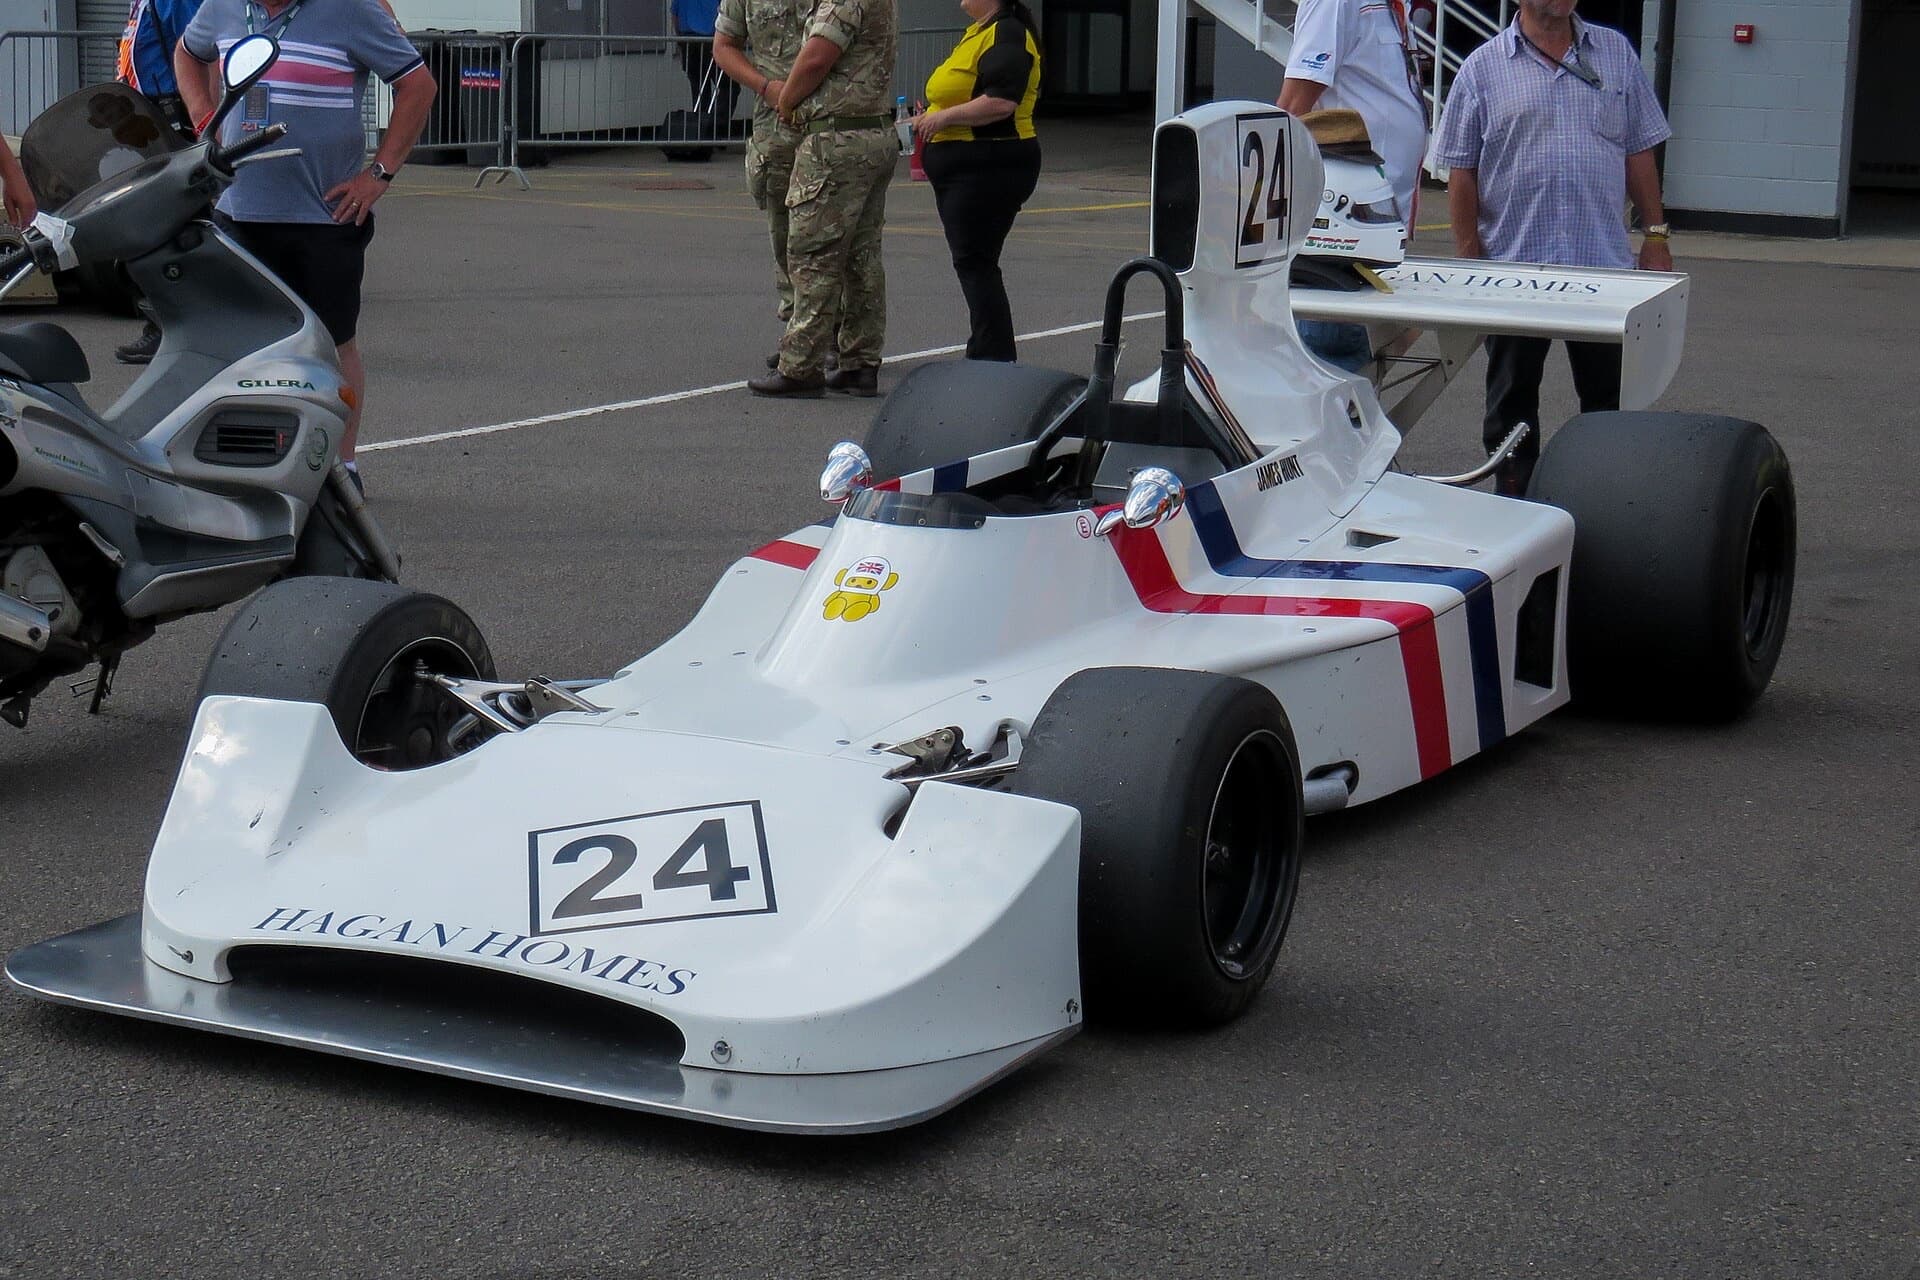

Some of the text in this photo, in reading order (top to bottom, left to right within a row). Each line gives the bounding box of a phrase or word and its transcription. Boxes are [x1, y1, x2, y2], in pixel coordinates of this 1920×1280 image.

[1240, 128, 1288, 246] 24
[1376, 270, 1601, 295] GAN HOMES
[237, 379, 316, 392] GILERA
[1256, 454, 1304, 492] JAMES HUNT
[551, 818, 751, 920] 24
[253, 907, 698, 997] HAGAN HOMES
